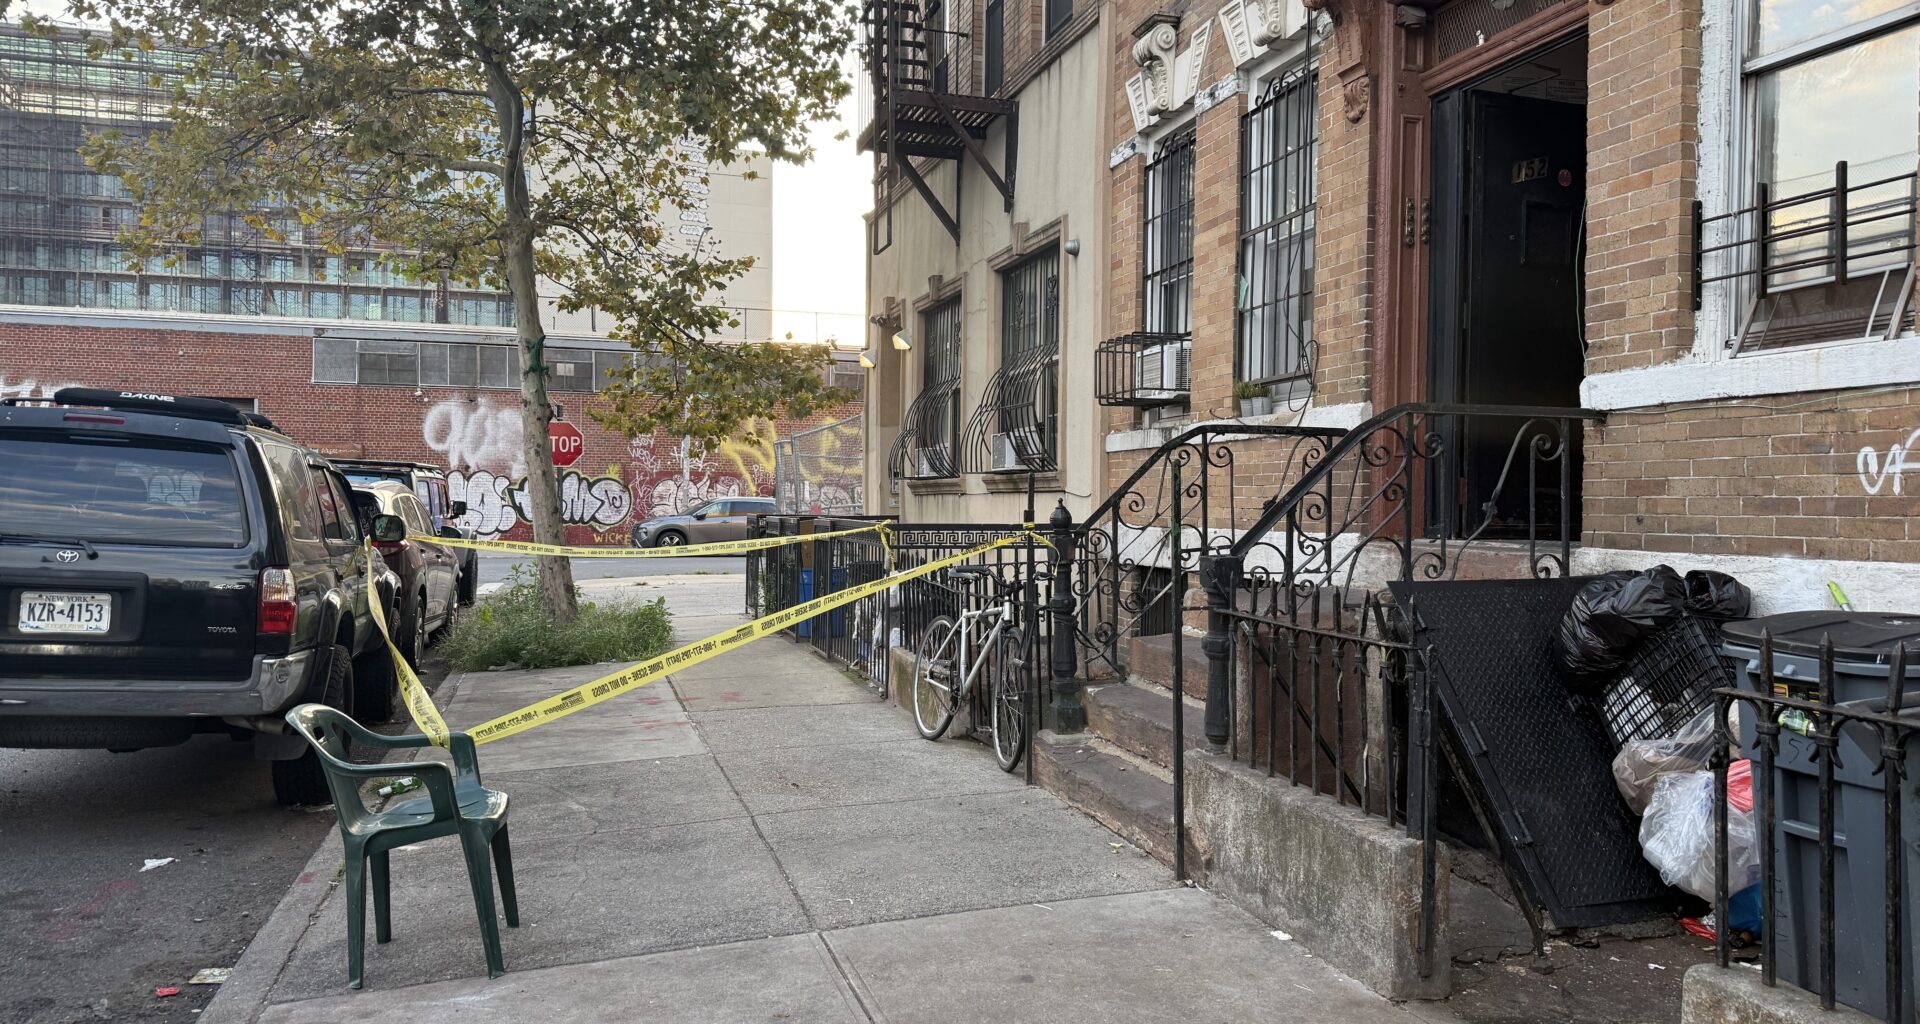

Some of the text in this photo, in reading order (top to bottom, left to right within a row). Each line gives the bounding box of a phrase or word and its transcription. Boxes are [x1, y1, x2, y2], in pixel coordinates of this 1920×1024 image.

[1517, 158, 1546, 179] 152
[119, 391, 175, 403] DAKINE
[550, 436, 581, 453] TOP
[66, 595, 89, 603] YORK
[207, 626, 237, 634] TOYOTA
